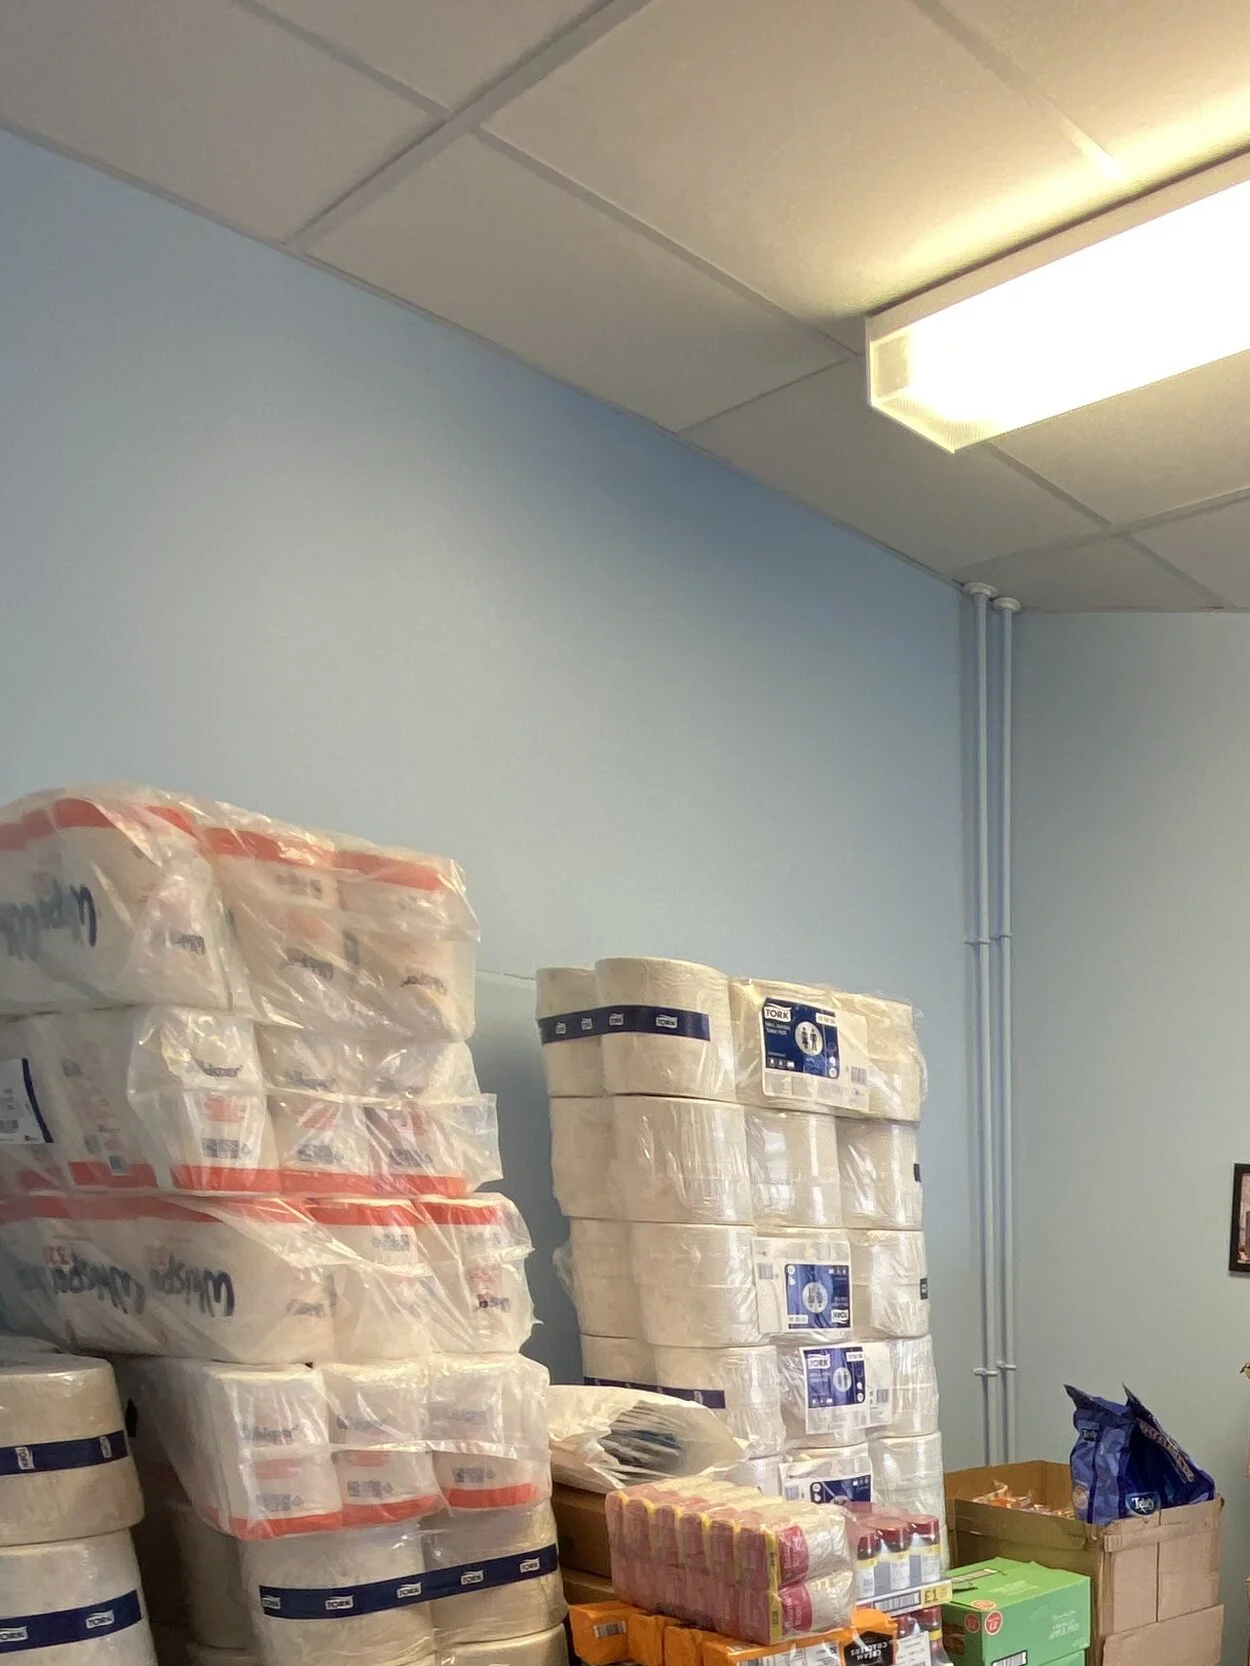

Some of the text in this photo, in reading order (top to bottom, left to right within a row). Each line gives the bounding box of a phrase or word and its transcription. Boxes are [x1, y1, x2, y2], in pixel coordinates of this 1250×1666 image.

[766, 1008, 789, 1019] TORK
[462, 1573, 482, 1584] TORK
[399, 1586, 421, 1597] TORK
[327, 1600, 352, 1610] TORK
[88, 1616, 113, 1628] TORK
